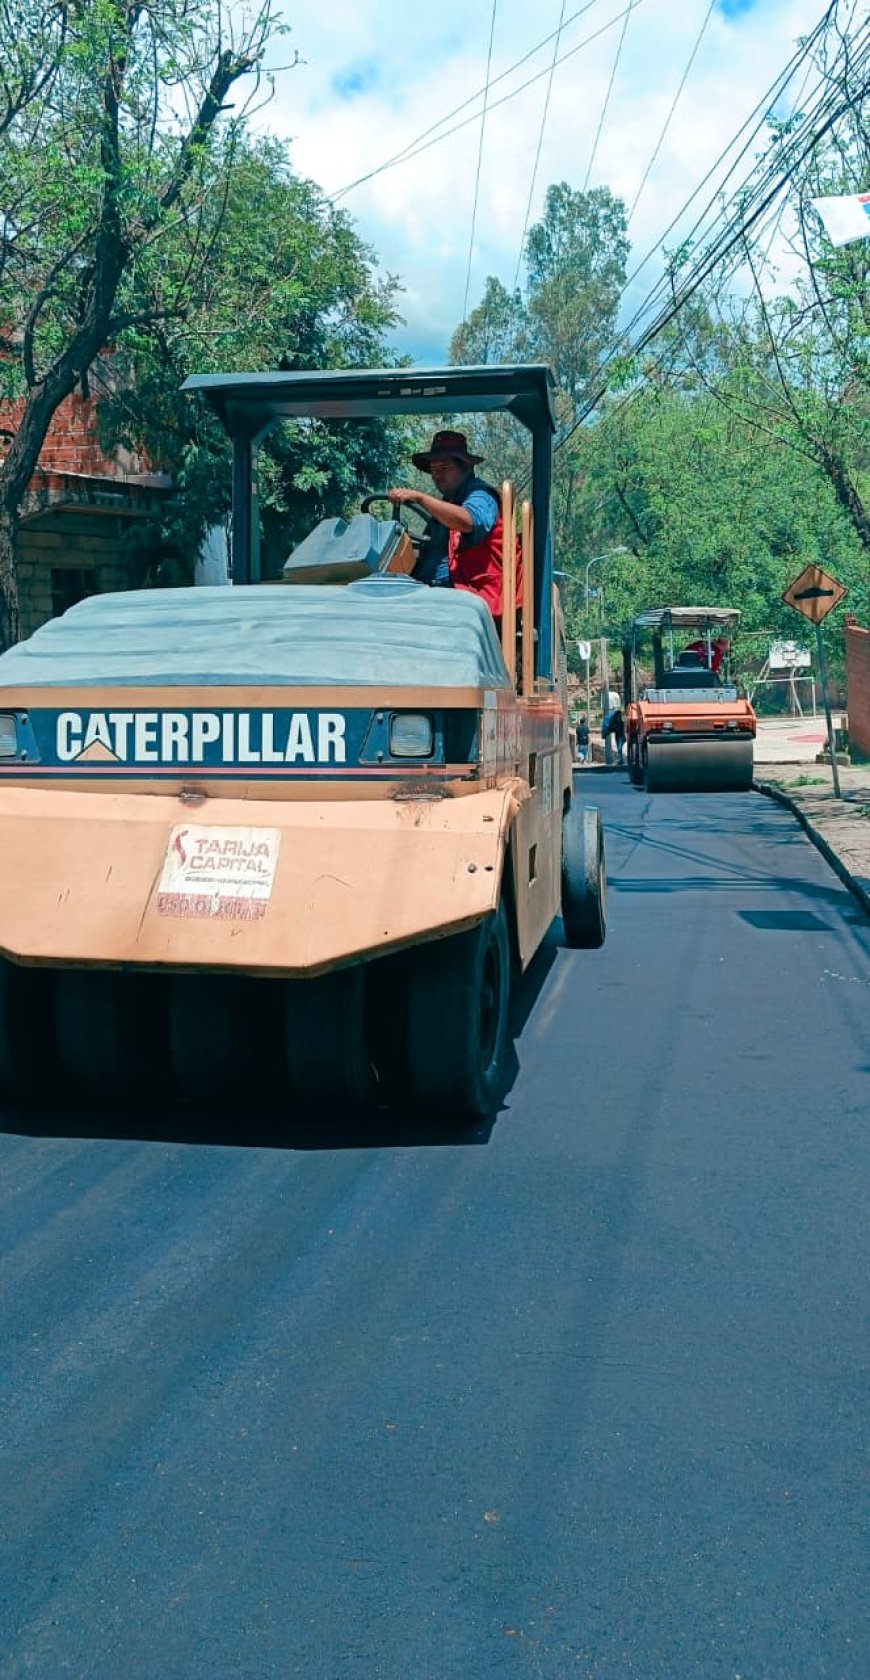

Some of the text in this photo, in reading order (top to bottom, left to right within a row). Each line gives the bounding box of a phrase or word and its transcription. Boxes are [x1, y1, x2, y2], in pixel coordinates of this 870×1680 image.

[56, 712, 346, 762] CATERPILLAR
[195, 839, 270, 857] TARIJA
[189, 855, 269, 873] CAPITAL
